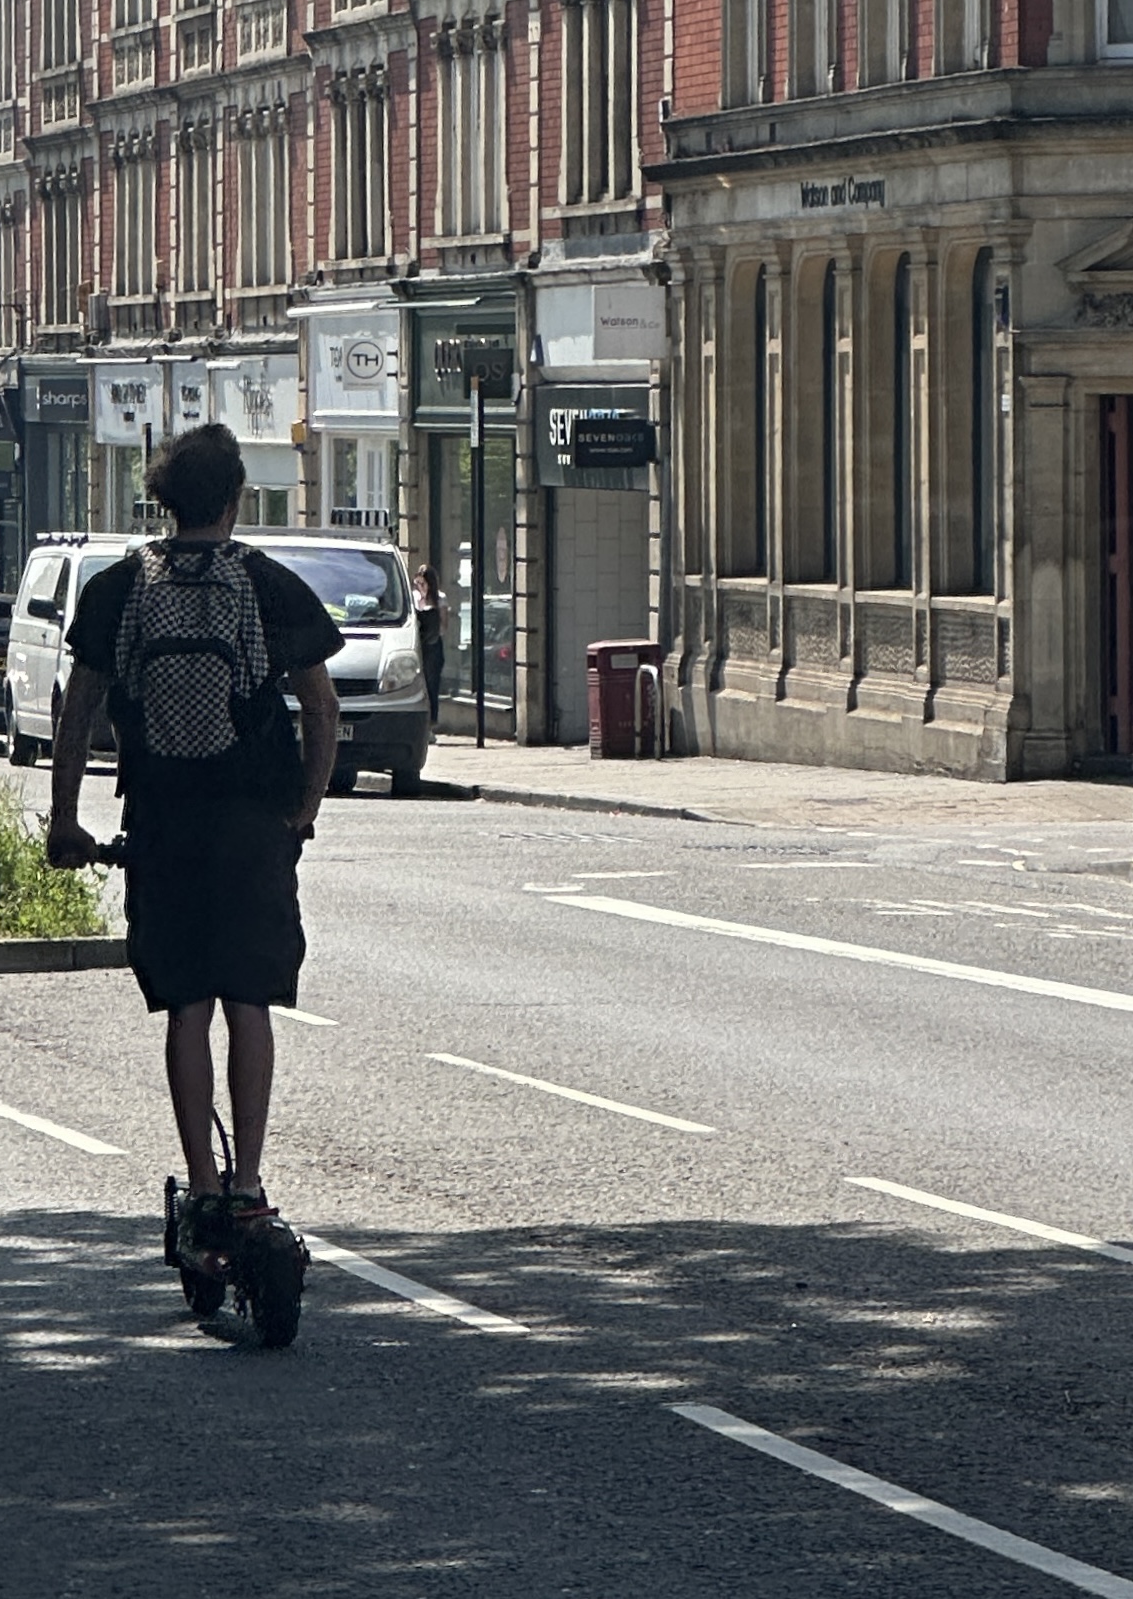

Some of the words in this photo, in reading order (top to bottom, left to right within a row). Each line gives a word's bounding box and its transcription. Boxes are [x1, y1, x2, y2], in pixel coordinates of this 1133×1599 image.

[800, 180, 829, 209] Watson
[830, 177, 846, 207] and
[848, 175, 886, 210] Company
[600, 316, 638, 327] Watson
[352, 353, 379, 367] TH
[42, 390, 87, 409] sharps
